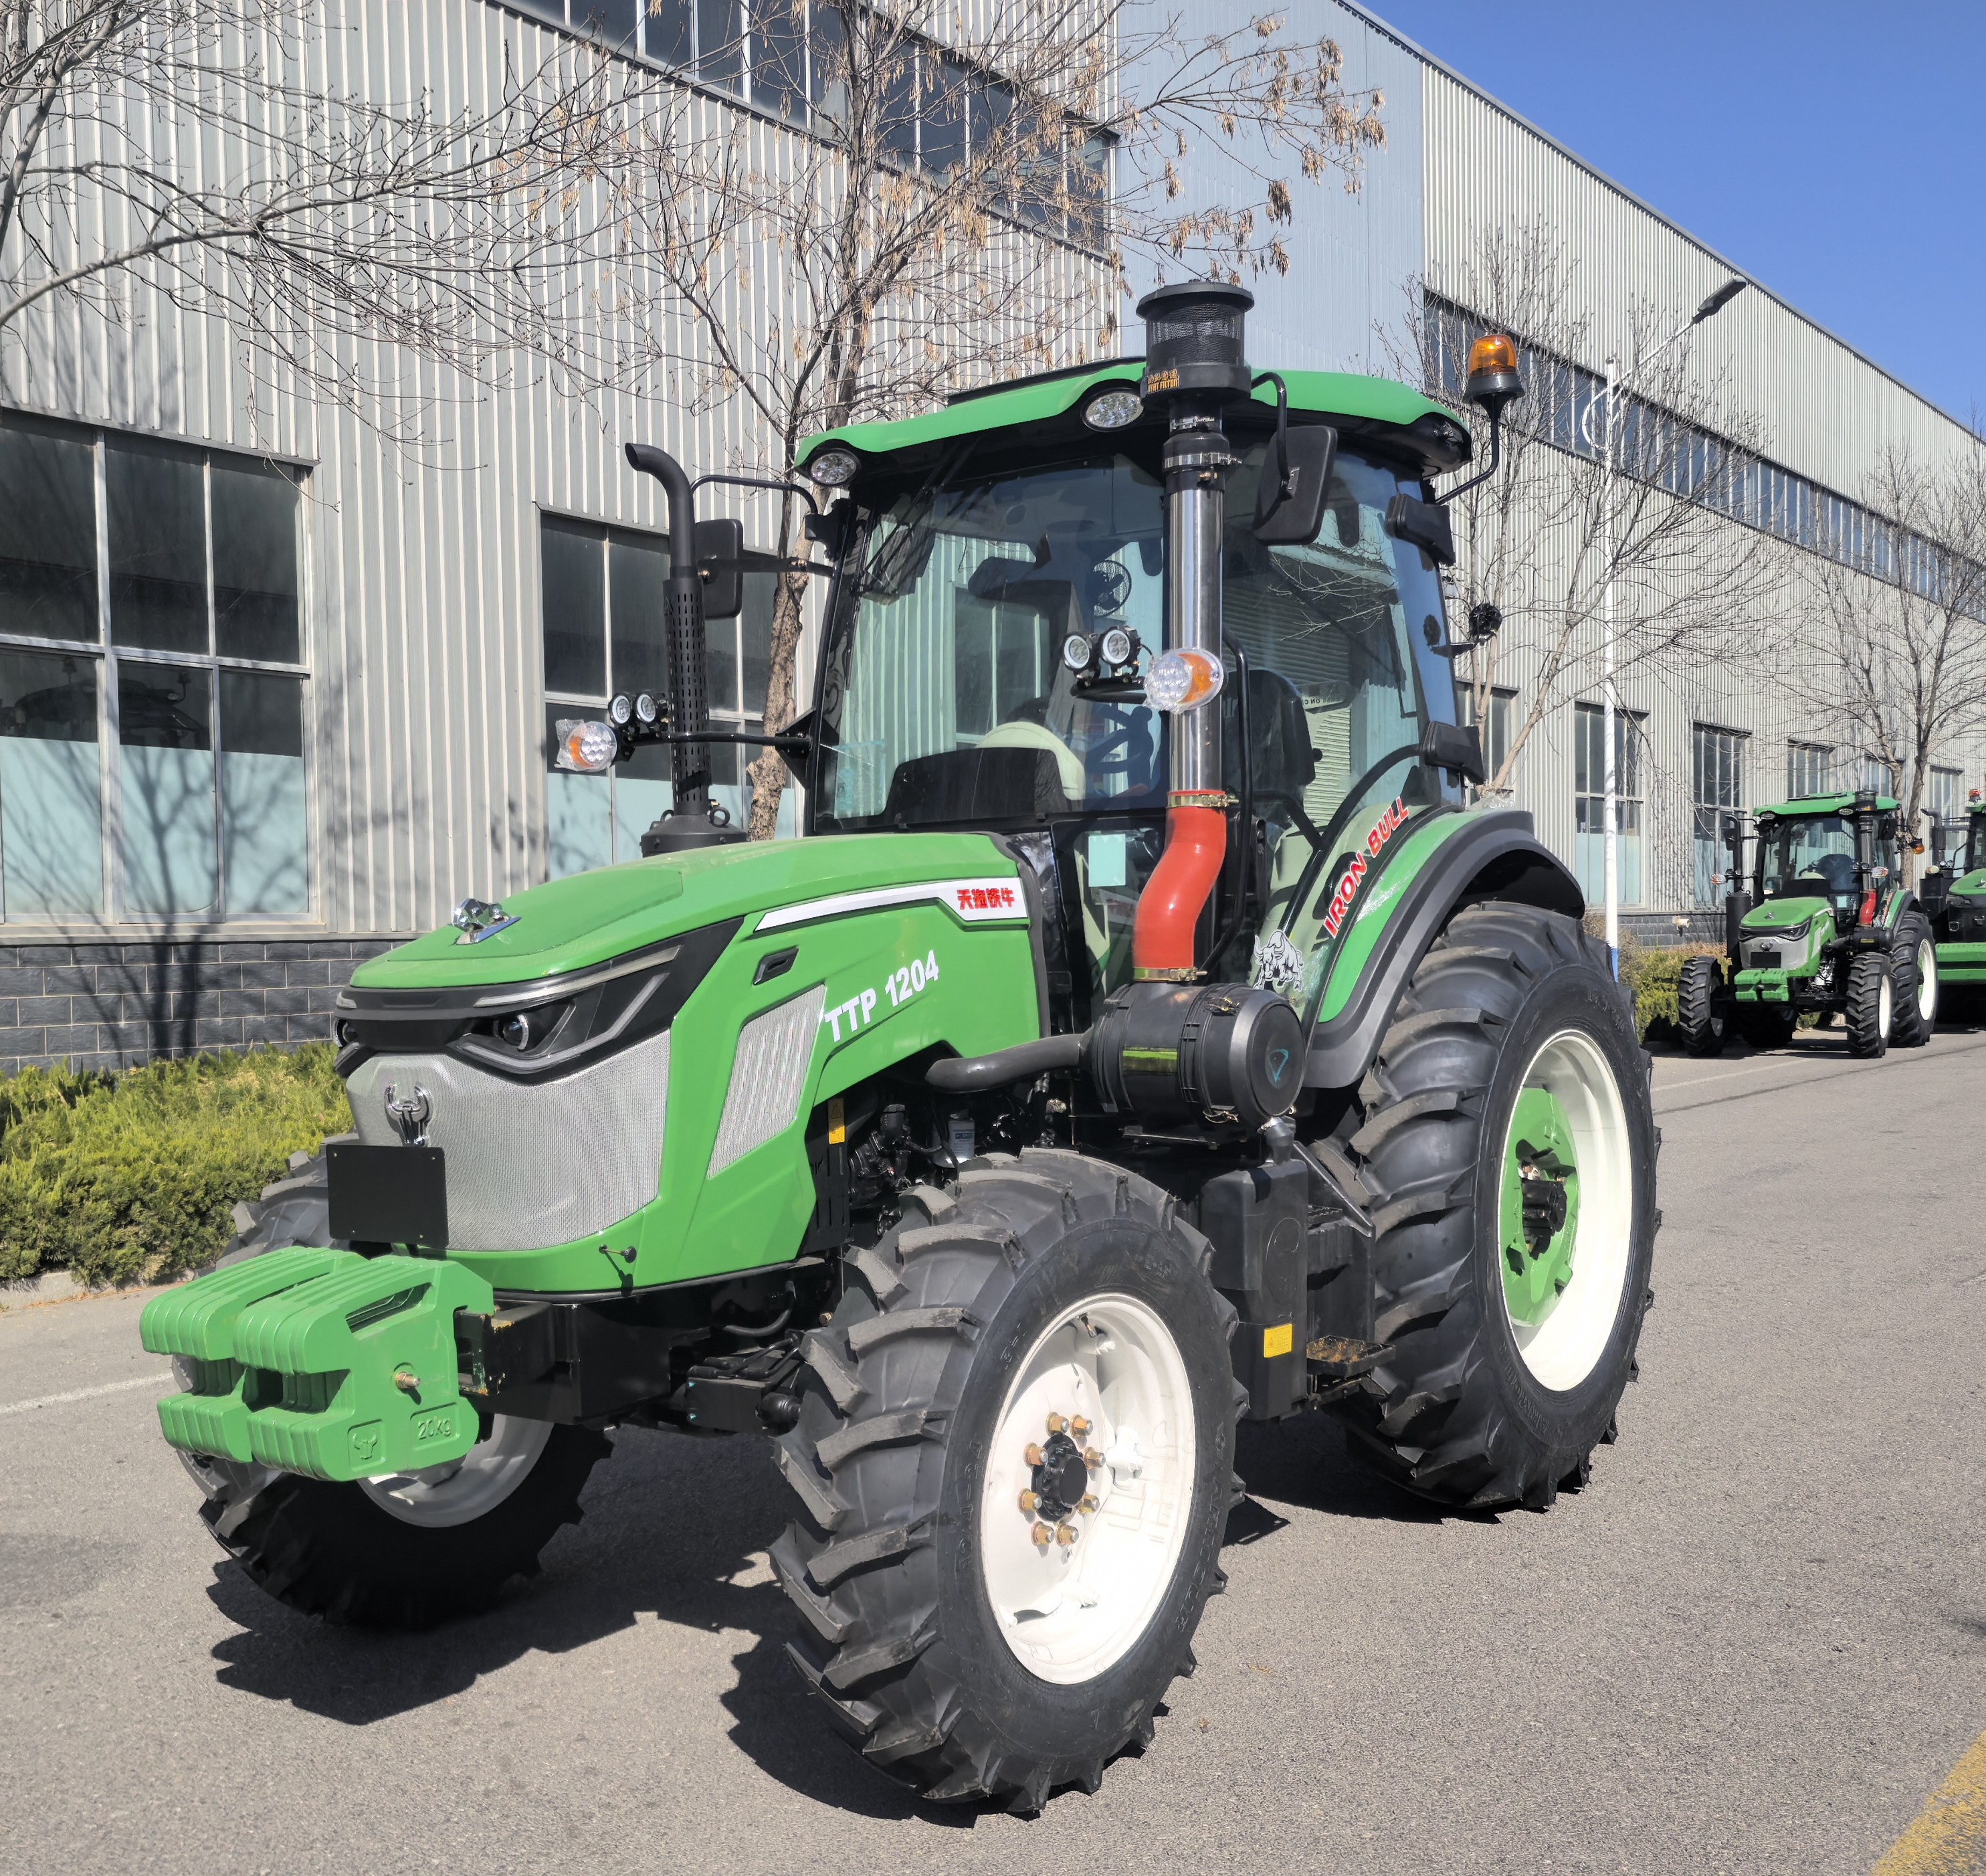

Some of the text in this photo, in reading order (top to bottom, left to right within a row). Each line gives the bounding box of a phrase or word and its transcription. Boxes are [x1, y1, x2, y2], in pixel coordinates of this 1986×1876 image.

[1324, 796, 1409, 939] IRON BULL
[824, 949, 939, 1042] TTP 1204
